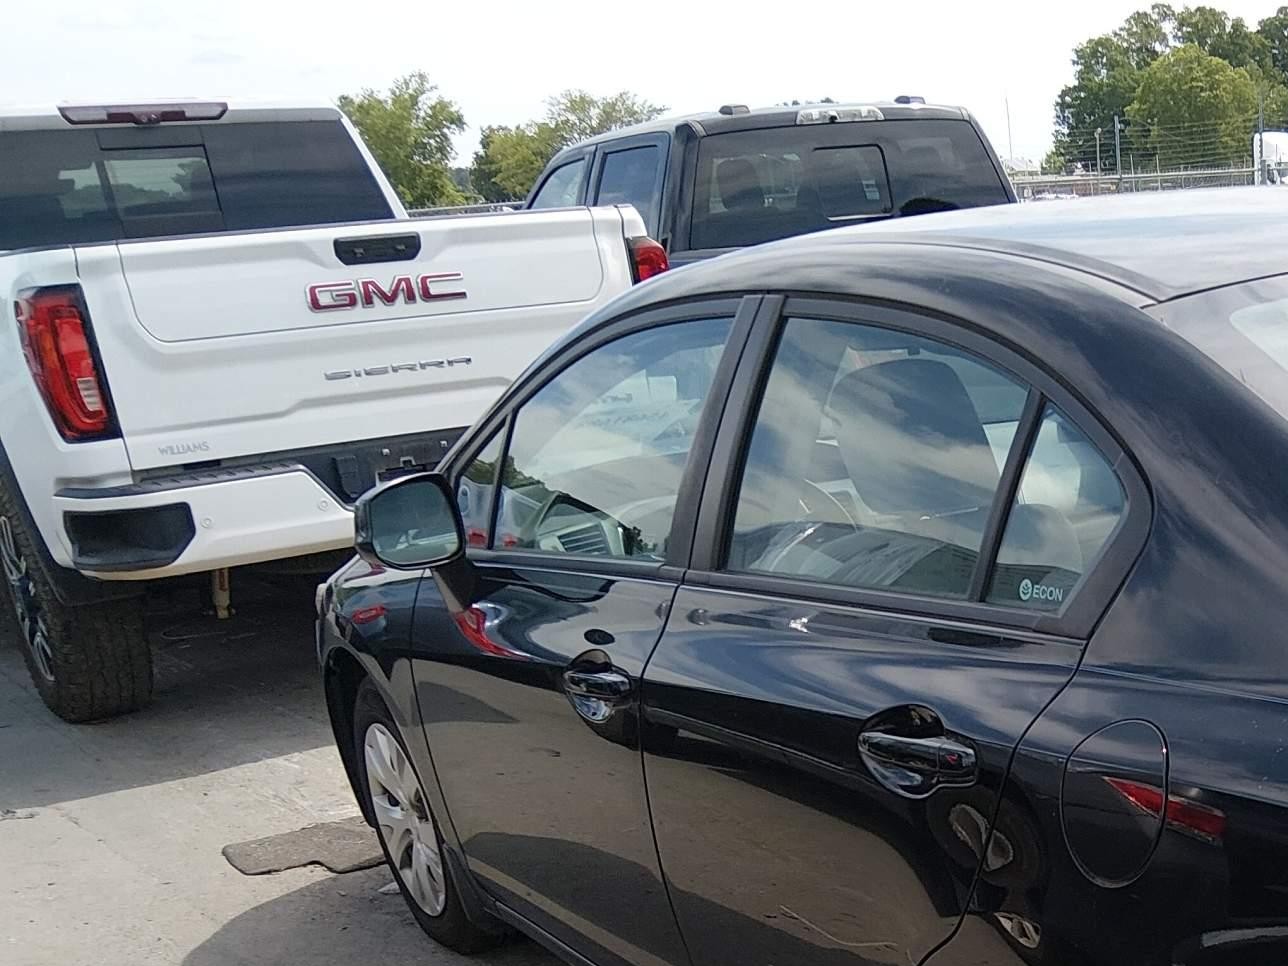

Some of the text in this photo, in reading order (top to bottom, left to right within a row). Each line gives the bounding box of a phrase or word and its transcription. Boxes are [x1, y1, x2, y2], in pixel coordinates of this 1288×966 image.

[307, 271, 468, 313] GMC
[324, 355, 473, 381] SIERRA
[157, 440, 210, 456] WILLIAMS
[1032, 584, 1064, 602] ECON
